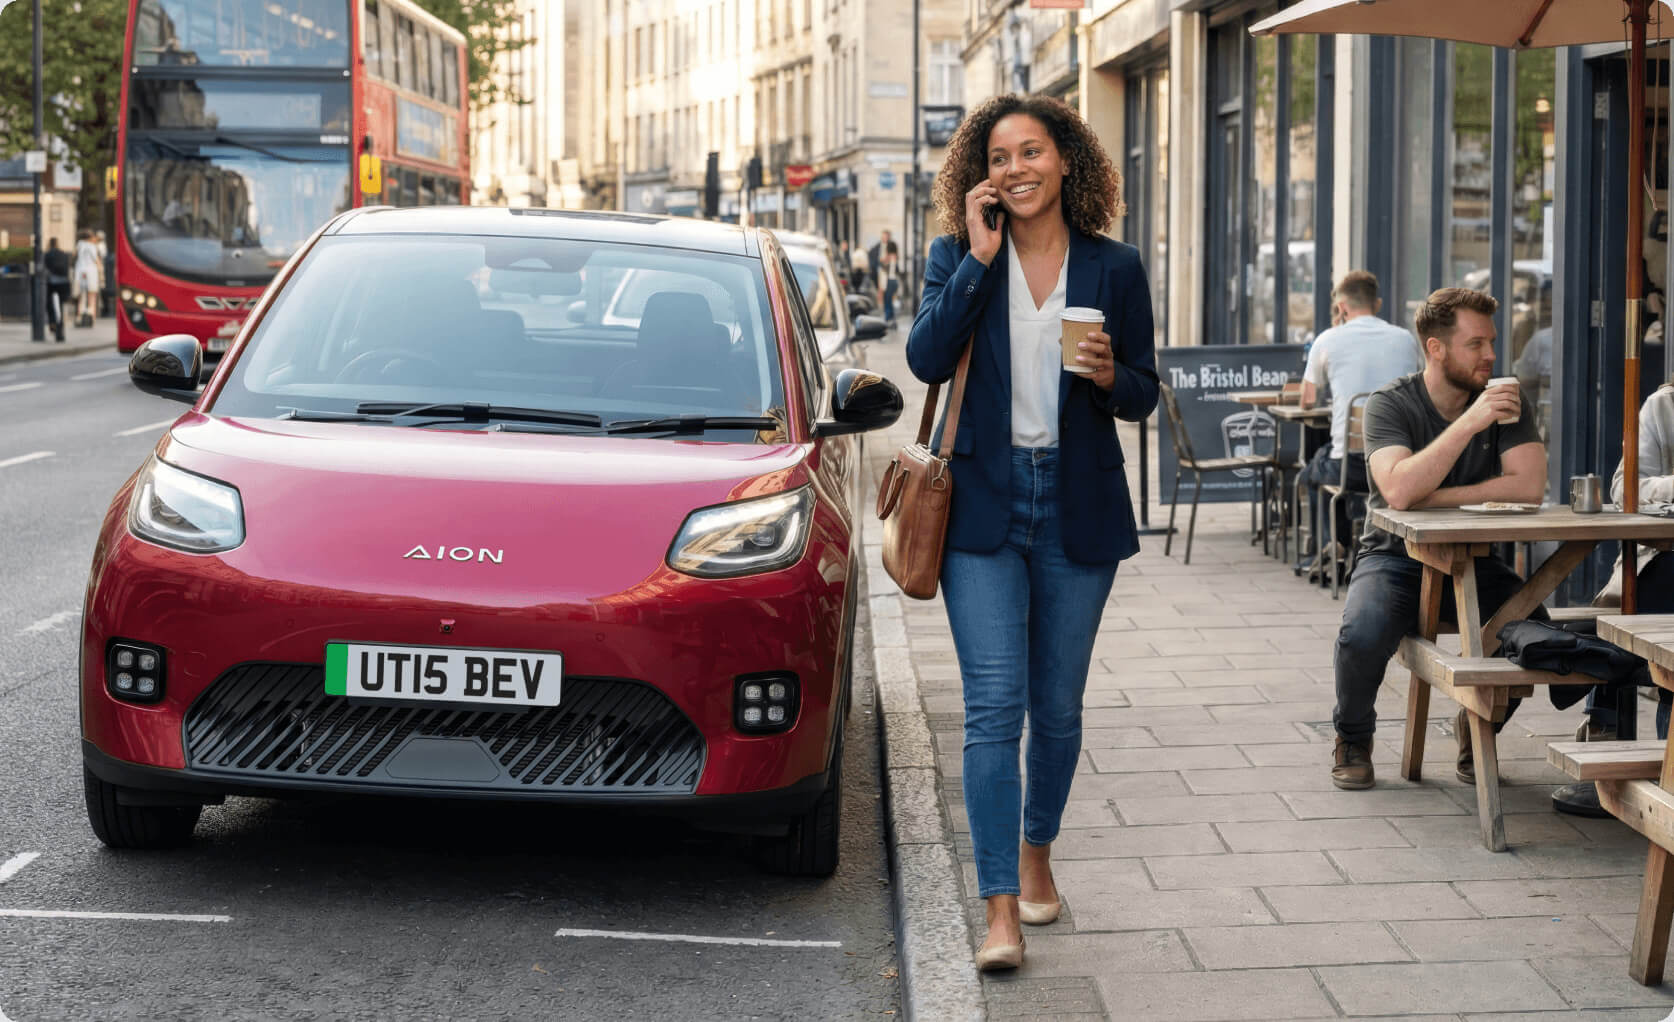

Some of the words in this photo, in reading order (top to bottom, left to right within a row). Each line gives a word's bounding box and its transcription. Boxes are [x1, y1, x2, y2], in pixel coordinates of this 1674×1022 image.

[1168, 366, 1197, 389] The
[1200, 364, 1248, 388] Bristol
[1251, 365, 1289, 387] Bean
[403, 544, 504, 564] AION
[360, 651, 449, 695] UT15
[463, 656, 545, 700] BEV
